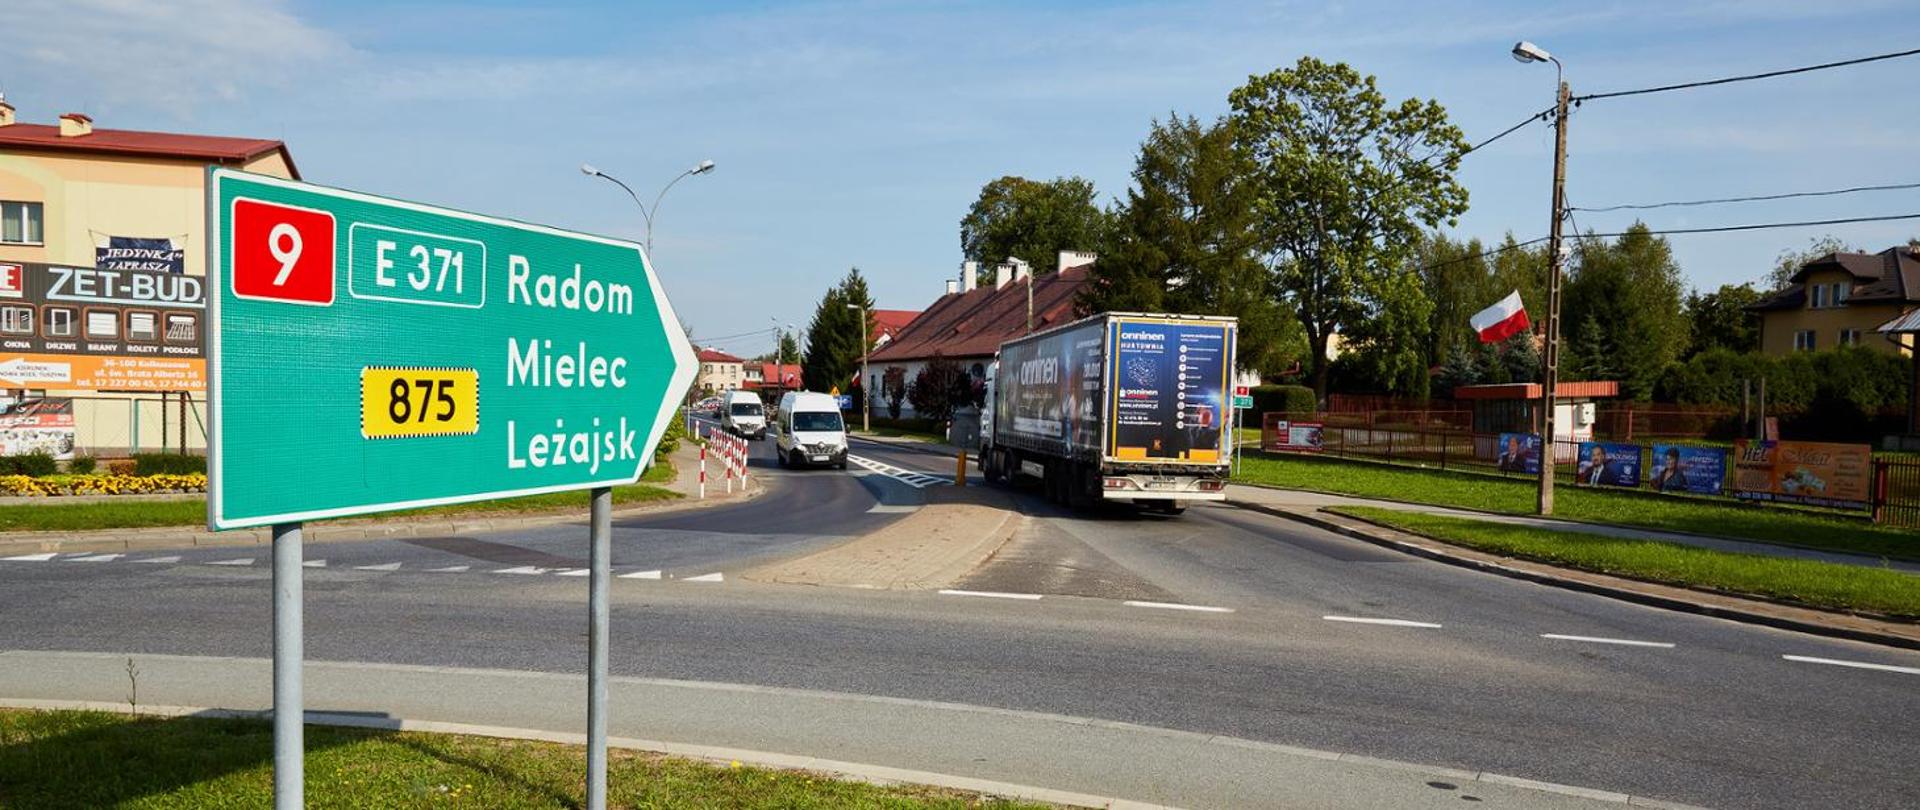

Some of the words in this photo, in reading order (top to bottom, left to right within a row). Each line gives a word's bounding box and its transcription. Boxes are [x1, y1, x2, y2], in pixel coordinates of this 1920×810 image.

[107, 261, 171, 272] ZAPRASZA
[268, 223, 302, 285] 9
[375, 239, 396, 287] E
[407, 244, 463, 294] 371
[508, 254, 633, 315] Radom
[4, 341, 31, 349] OKNA
[45, 342, 77, 351] DRZWI
[87, 343, 118, 352] BRAMY
[126, 345, 159, 353] ROLETY
[1121, 331, 1165, 341] onninen
[507, 336, 627, 388] Mielec
[1021, 357, 1058, 385] onninen
[389, 377, 456, 424] 875
[508, 417, 637, 476] Leżajsk
